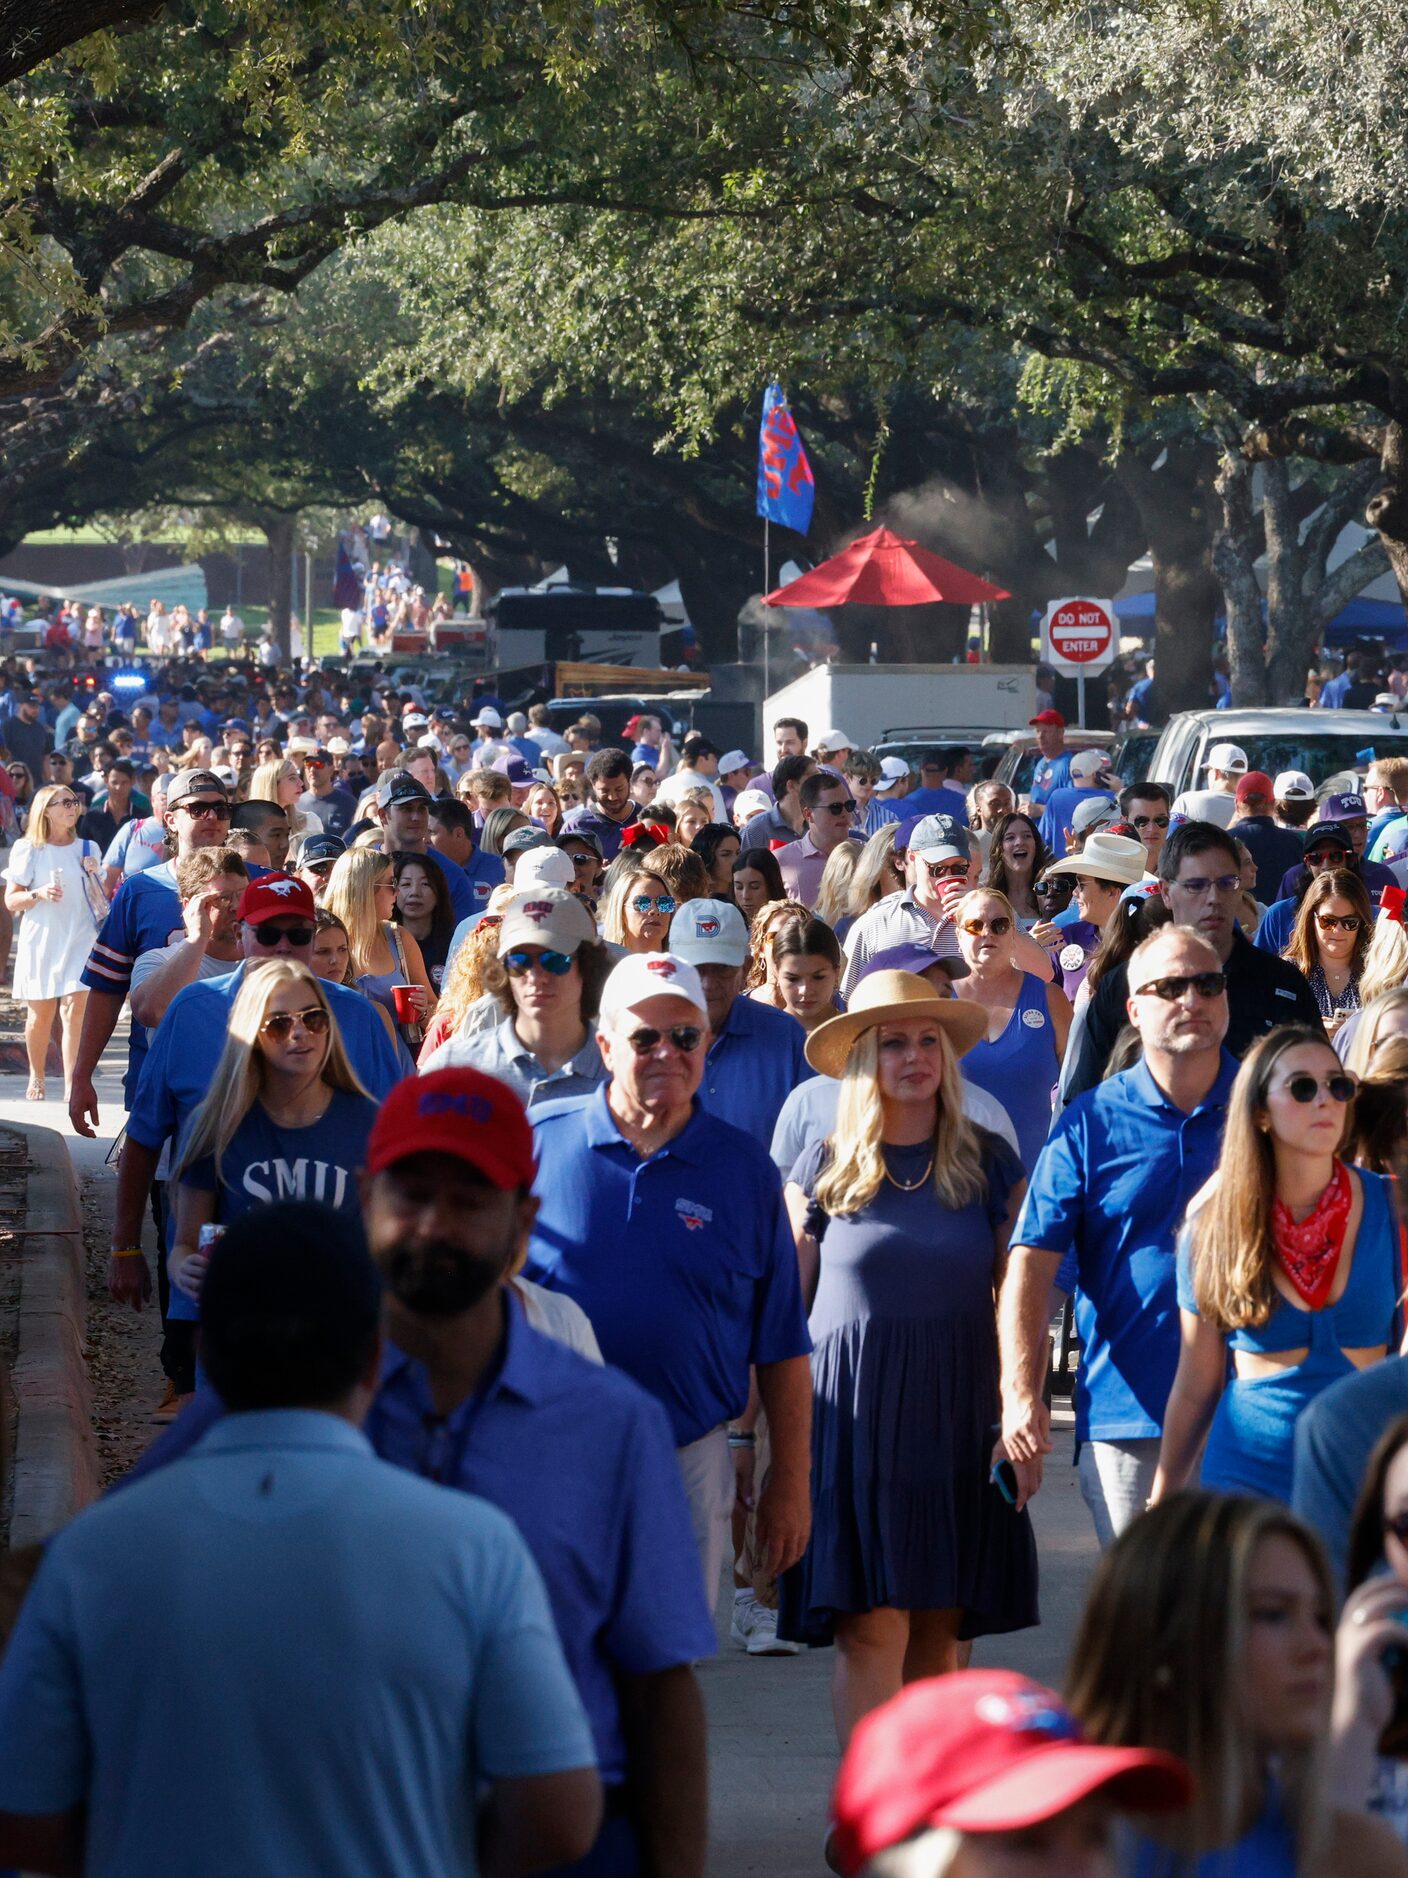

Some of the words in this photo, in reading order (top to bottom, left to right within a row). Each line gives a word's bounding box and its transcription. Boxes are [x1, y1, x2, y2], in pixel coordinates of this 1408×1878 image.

[1058, 613, 1075, 625] DO
[1079, 612, 1100, 624] NOT
[1062, 640, 1098, 653] ENTER
[1341, 795, 1362, 809] TCU
[242, 1158, 349, 1210] SMU
[674, 1197, 713, 1222] SMU
